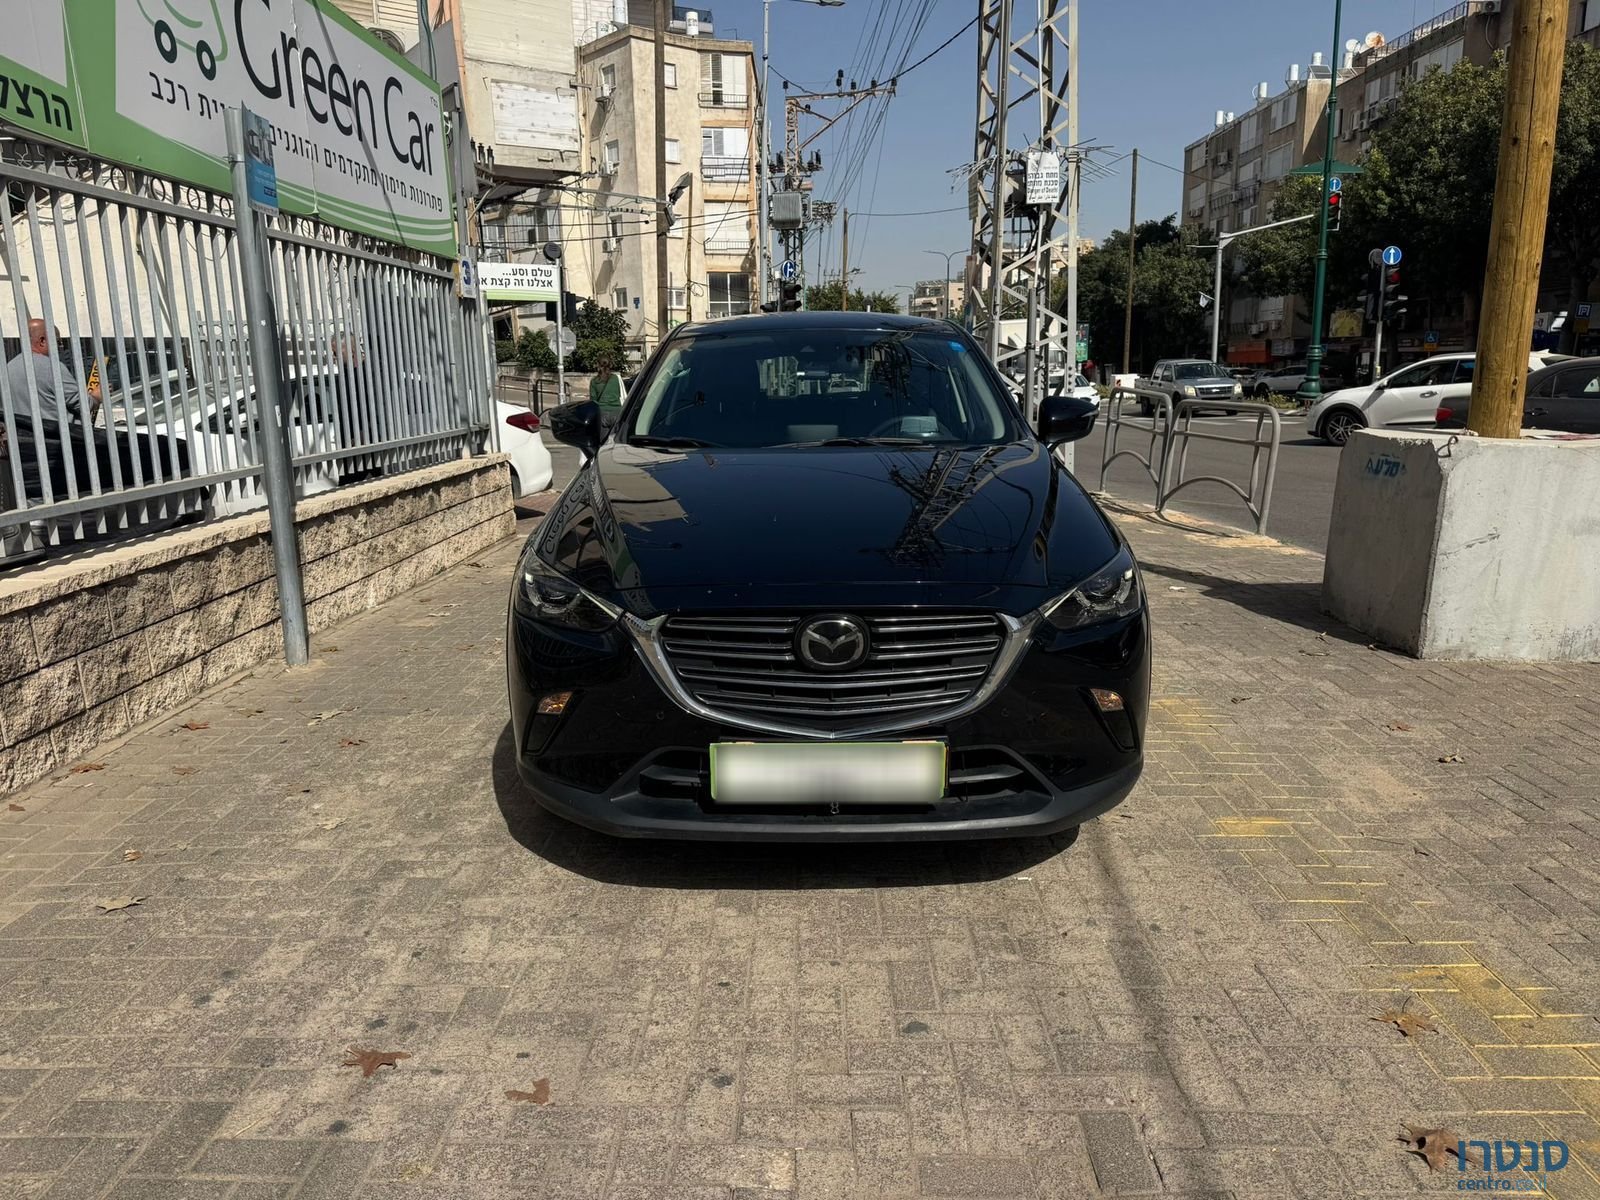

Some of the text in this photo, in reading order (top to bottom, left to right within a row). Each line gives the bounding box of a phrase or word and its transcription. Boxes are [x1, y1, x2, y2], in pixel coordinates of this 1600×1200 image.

[149, 71, 190, 111] רכב
[234, 0, 434, 176] Green Car
[324, 148, 378, 186] מתקדמים
[381, 172, 407, 198] מימון
[410, 185, 443, 213] פתרונות
[491, 278, 511, 288] קצת
[502, 267, 552, 277] שלם וסע...
[514, 278, 525, 286] זה
[527, 278, 553, 288] אצלנו
